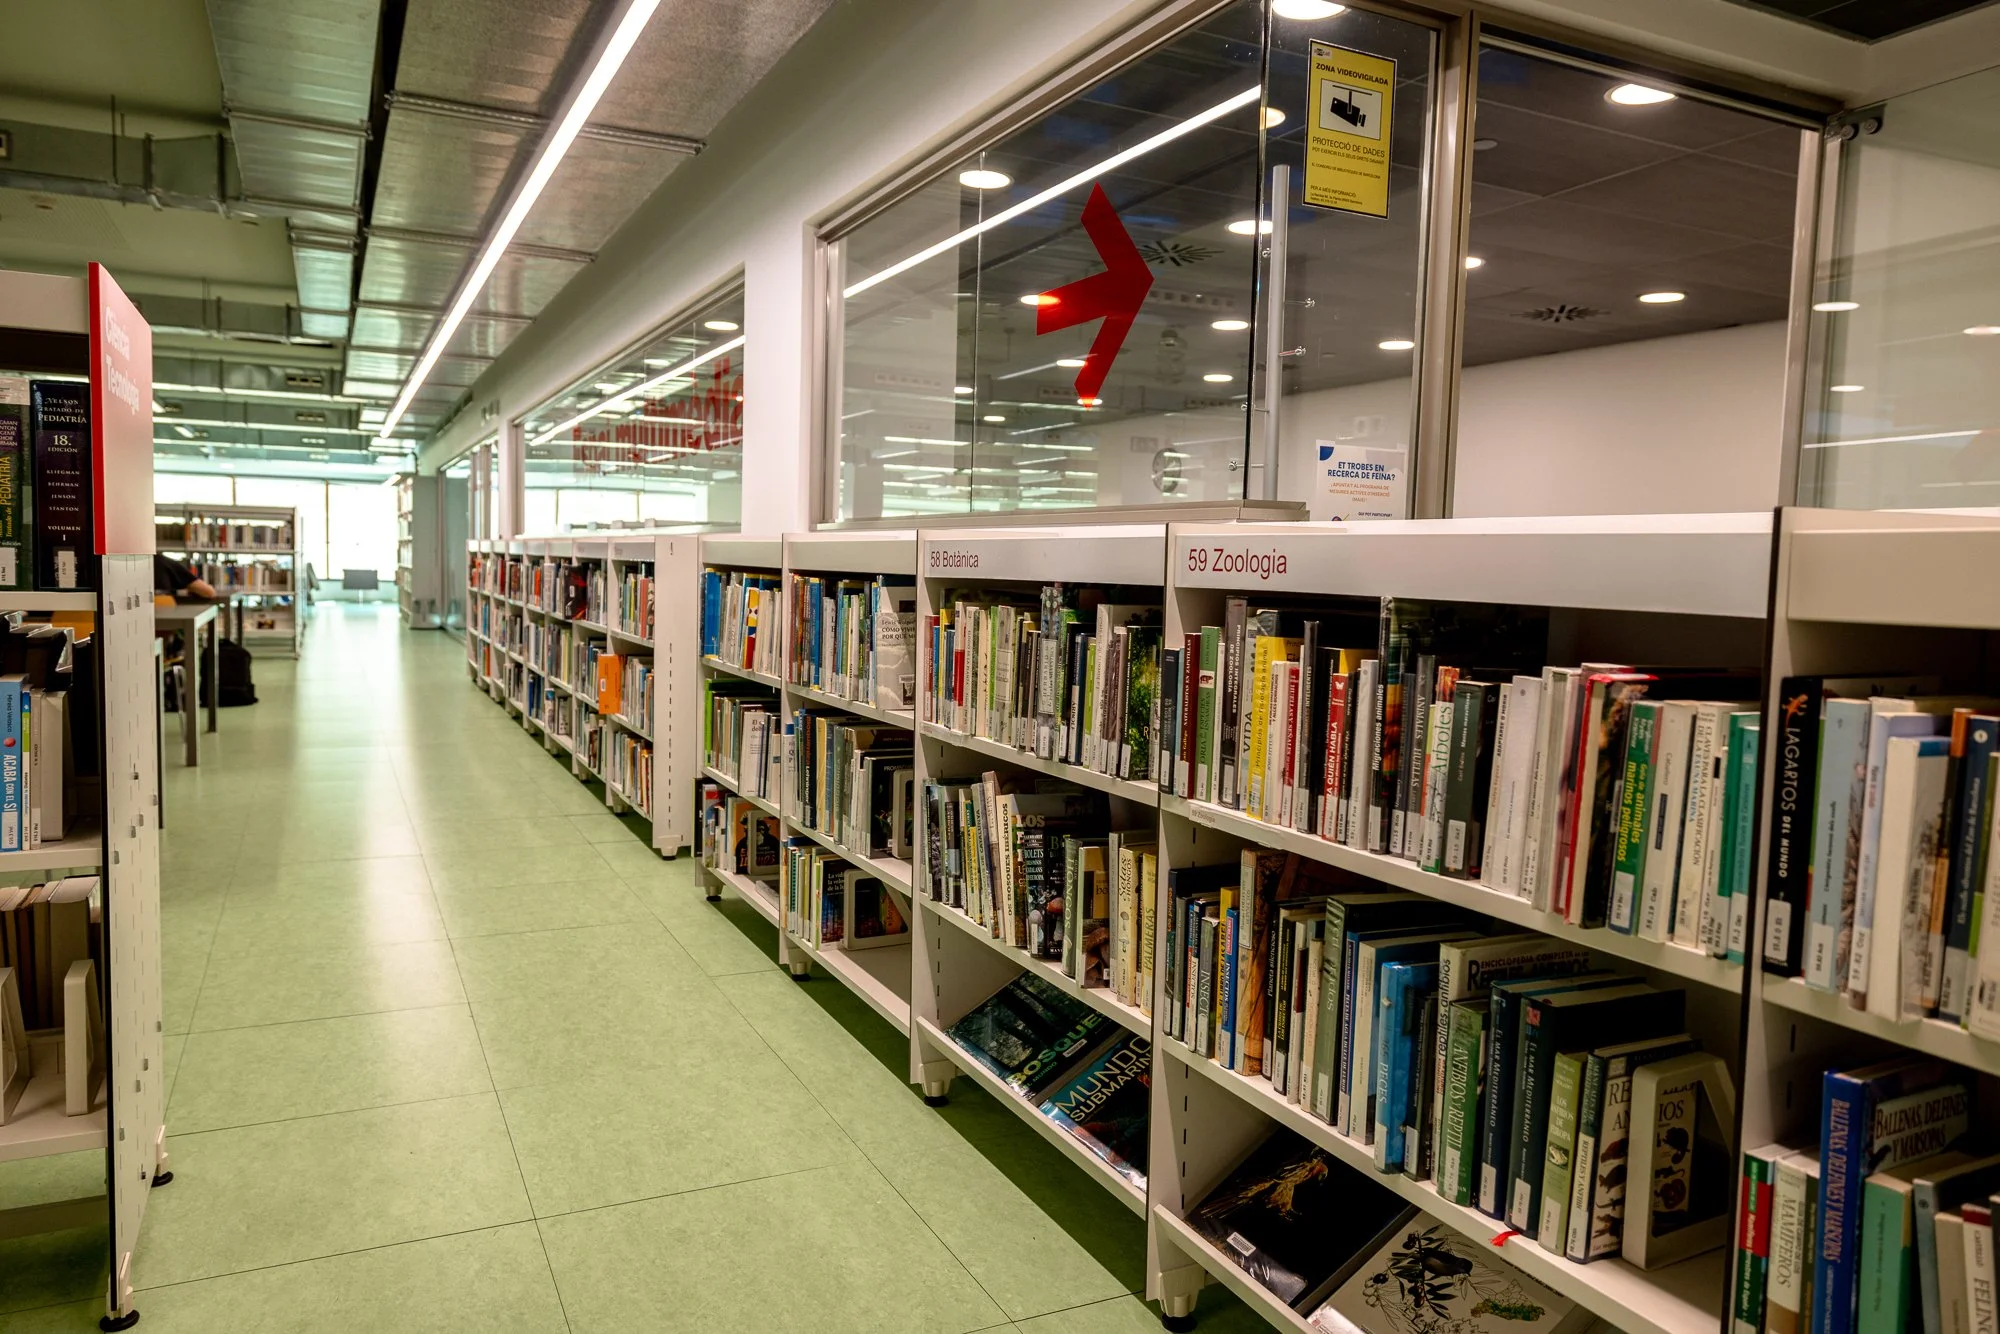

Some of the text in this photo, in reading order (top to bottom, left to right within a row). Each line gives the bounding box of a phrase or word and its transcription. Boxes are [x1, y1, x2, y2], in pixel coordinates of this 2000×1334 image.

[1316, 63, 1389, 86] ZONA VIDEOVIGILADA
[1312, 136, 1385, 158] PROTECCIÓ DE DADES
[38, 414, 88, 424] PEDIATRÍA
[1328, 469, 1396, 481] RECERCA DE FEINA?
[1347, 463, 1373, 471] TROBES
[1375, 464, 1385, 472] EN
[930, 551, 979, 569] 58 Botànica
[1188, 548, 1288, 580] 59 Zoologia
[1304, 666, 1312, 707] INTELIGENTES
[1243, 711, 1253, 753] VIDA
[1372, 684, 1385, 771] Migraciones animales
[1414, 695, 1426, 740] ANIMALES
[1255, 729, 1263, 768] Principios
[1329, 721, 1338, 755] HABLA
[1703, 726, 1713, 761] CLAVES
[4, 754, 16, 783] ACABA
[1327, 757, 1337, 785] QUIÉN
[1411, 748, 1422, 788] HUELLAS
[1689, 725, 1704, 823] DE LA FAUNA MARINA
[1701, 762, 1710, 785] PARA
[3, 801, 16, 812] SI
[1615, 761, 1638, 862] marinos peligrosos
[1630, 792, 1647, 844] animales
[1778, 727, 1801, 878] LAGARTOS DEL MUNDO
[1693, 796, 1707, 866] CLASIFICACIÓN
[1064, 857, 1075, 929] HONGOS
[1143, 908, 1155, 971] PALMERAS
[1481, 951, 1573, 968] ENCICLOPEDIA COMPLETA
[1267, 931, 1276, 997] Planeta silencioso
[1438, 958, 1451, 1007] anfibios
[1437, 1011, 1448, 1057] reptiles
[1377, 1063, 1389, 1104] PECES
[1449, 1044, 1468, 1101] ANFIBIOS
[1489, 1030, 1503, 1127] EL MAR MEDITERRÁNEO
[1522, 1042, 1537, 1143] EL MAR MEDITERRÁNEO
[1556, 1095, 1569, 1108] LOS
[1555, 1117, 1564, 1128] DE
[1579, 1140, 1589, 1175] REPTILES
[1892, 1139, 1900, 1162] Y
[1827, 1152, 1847, 1201] DELFINES
